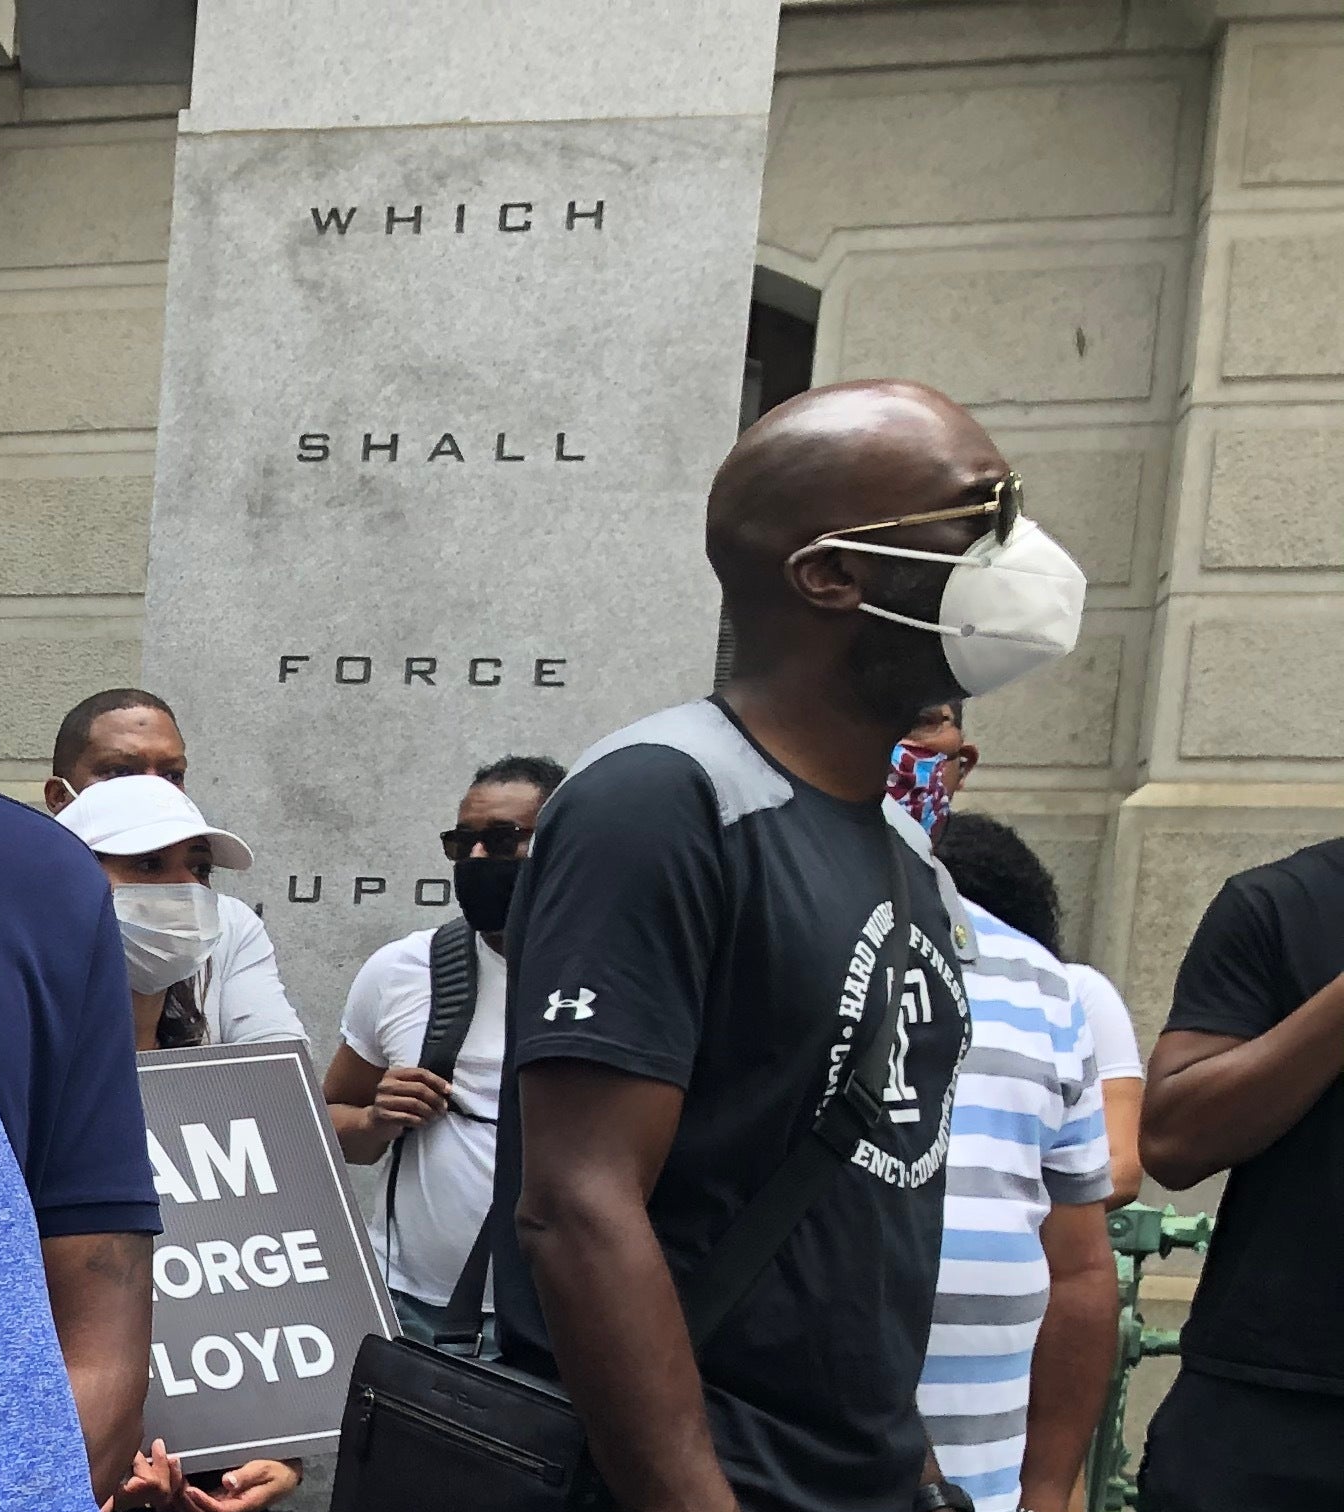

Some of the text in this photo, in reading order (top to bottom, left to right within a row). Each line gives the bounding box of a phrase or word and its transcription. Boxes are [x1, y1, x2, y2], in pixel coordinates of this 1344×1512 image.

[311, 200, 605, 236] WHICH
[296, 431, 587, 463] SHALL
[278, 655, 568, 687] FORCE
[287, 875, 452, 907] UPO
[838, 900, 969, 1023] HARD WOR FFNESS
[146, 1116, 279, 1204] AM
[850, 1138, 906, 1189] ENCY
[152, 1228, 330, 1302] ORGE
[148, 1323, 335, 1398] LOYD
